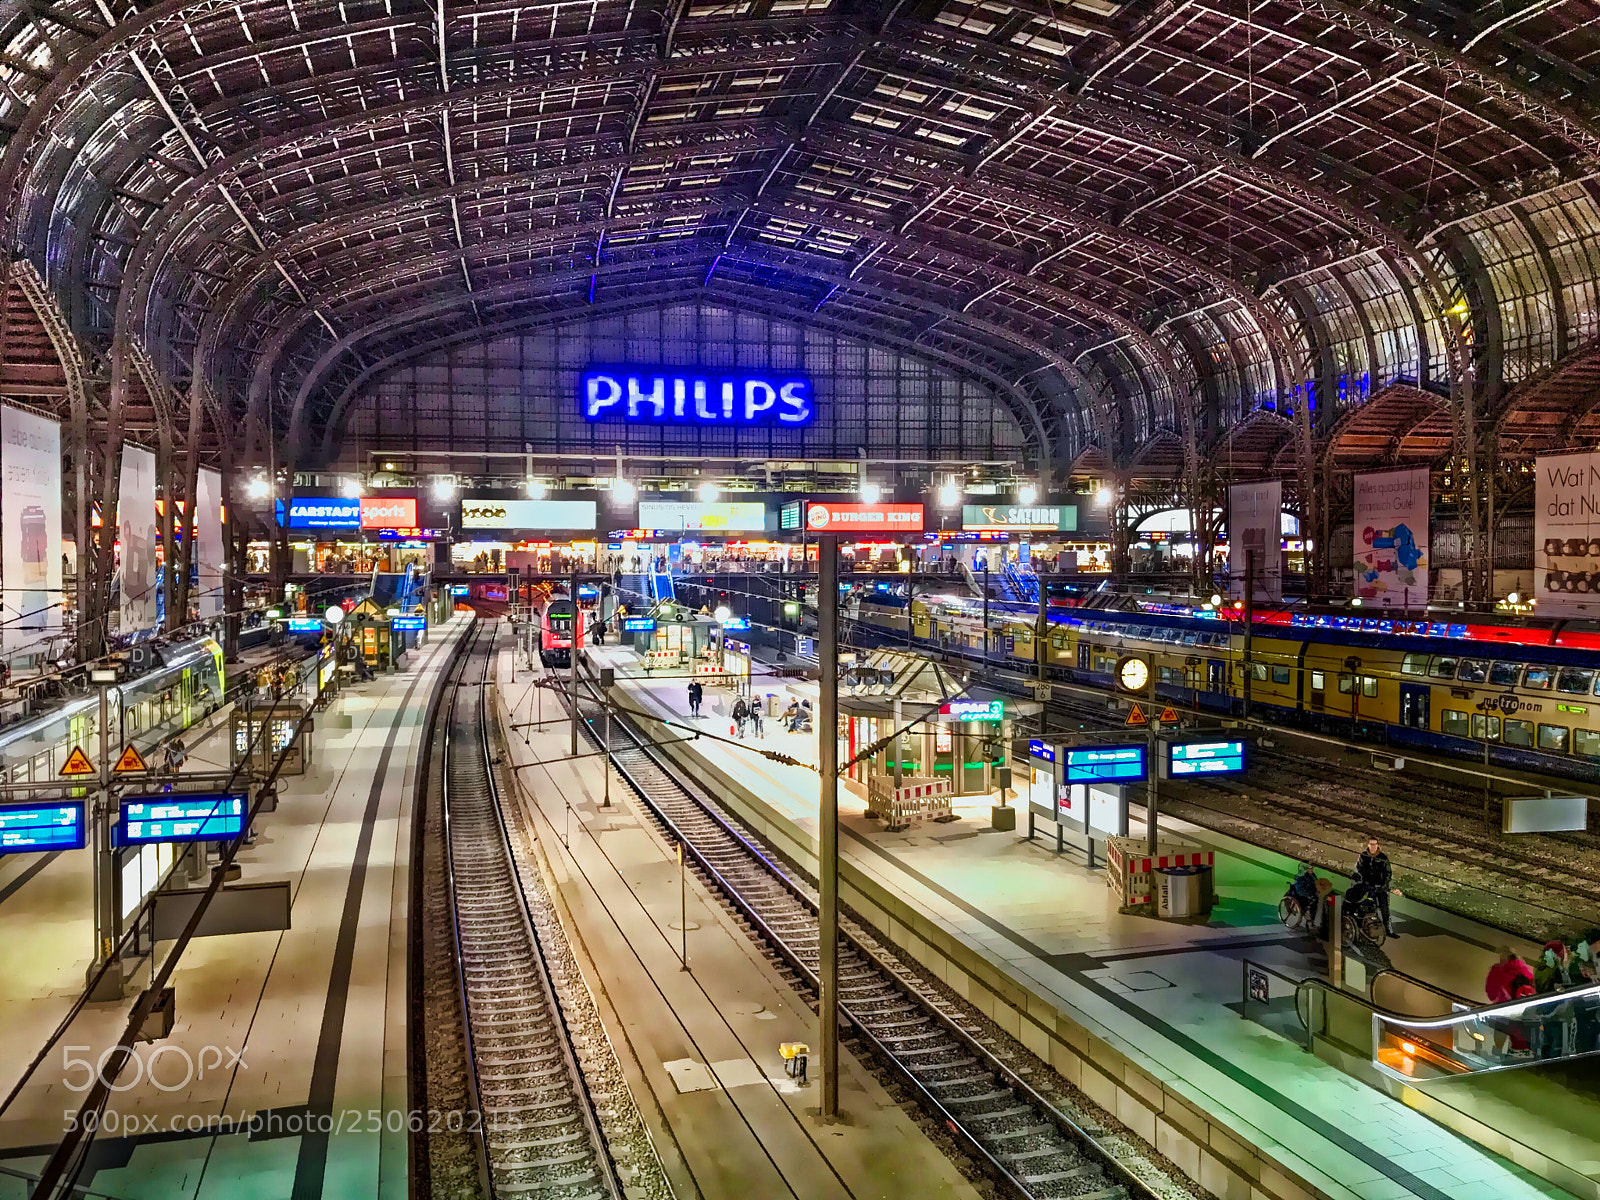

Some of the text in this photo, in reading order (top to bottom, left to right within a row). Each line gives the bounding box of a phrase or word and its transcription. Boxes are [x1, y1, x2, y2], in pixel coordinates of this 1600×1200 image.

[586, 375, 810, 422] PHILIPS
[1547, 466, 1584, 488] Wat
[290, 504, 405, 519] KARSTADT sports
[1547, 494, 1574, 516] dat
[832, 512, 921, 522] BURGER KING
[1008, 508, 1059, 524] SATURN
[798, 640, 807, 654] E
[1004, 637, 1013, 650] E
[132, 648, 144, 663] D
[1483, 695, 1543, 713] metronom
[1161, 885, 1169, 910] Abfall
